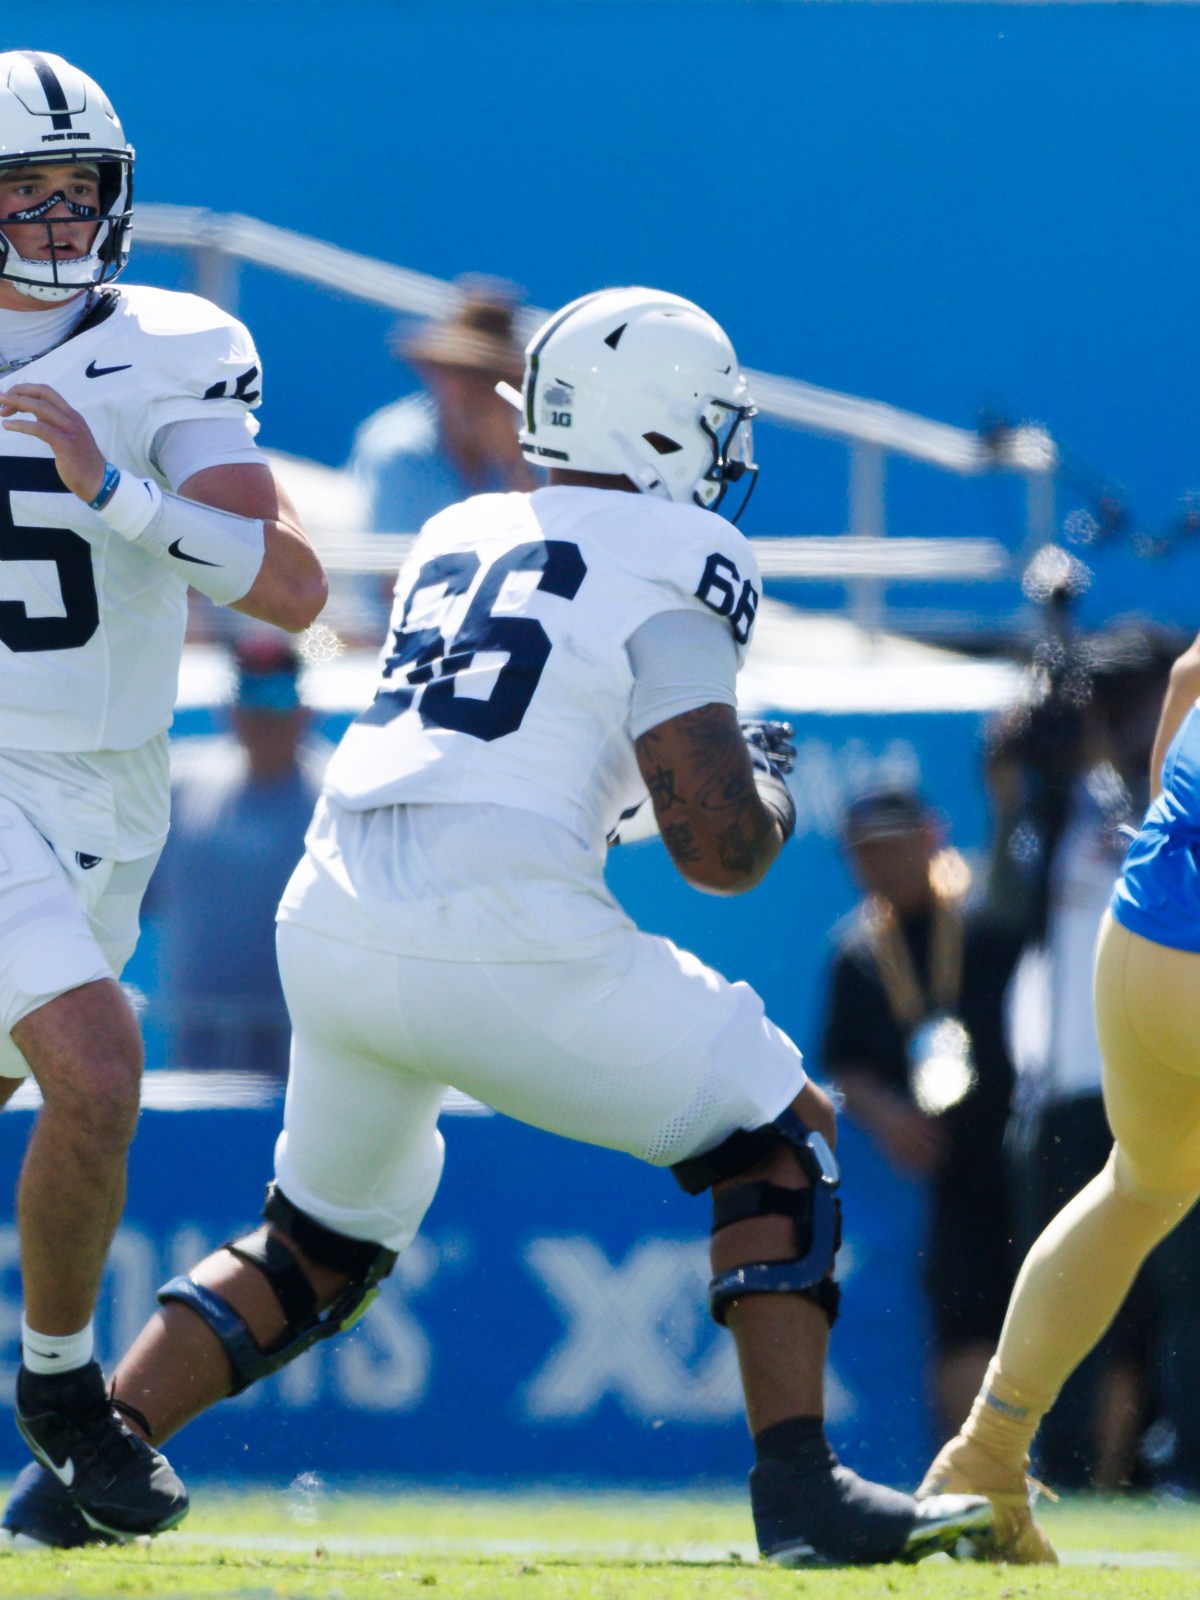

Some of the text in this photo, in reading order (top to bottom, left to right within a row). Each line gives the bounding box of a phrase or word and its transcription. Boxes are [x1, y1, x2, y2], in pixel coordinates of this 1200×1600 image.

[41, 132, 91, 143] PENN STATE
[694, 552, 759, 645] 66
